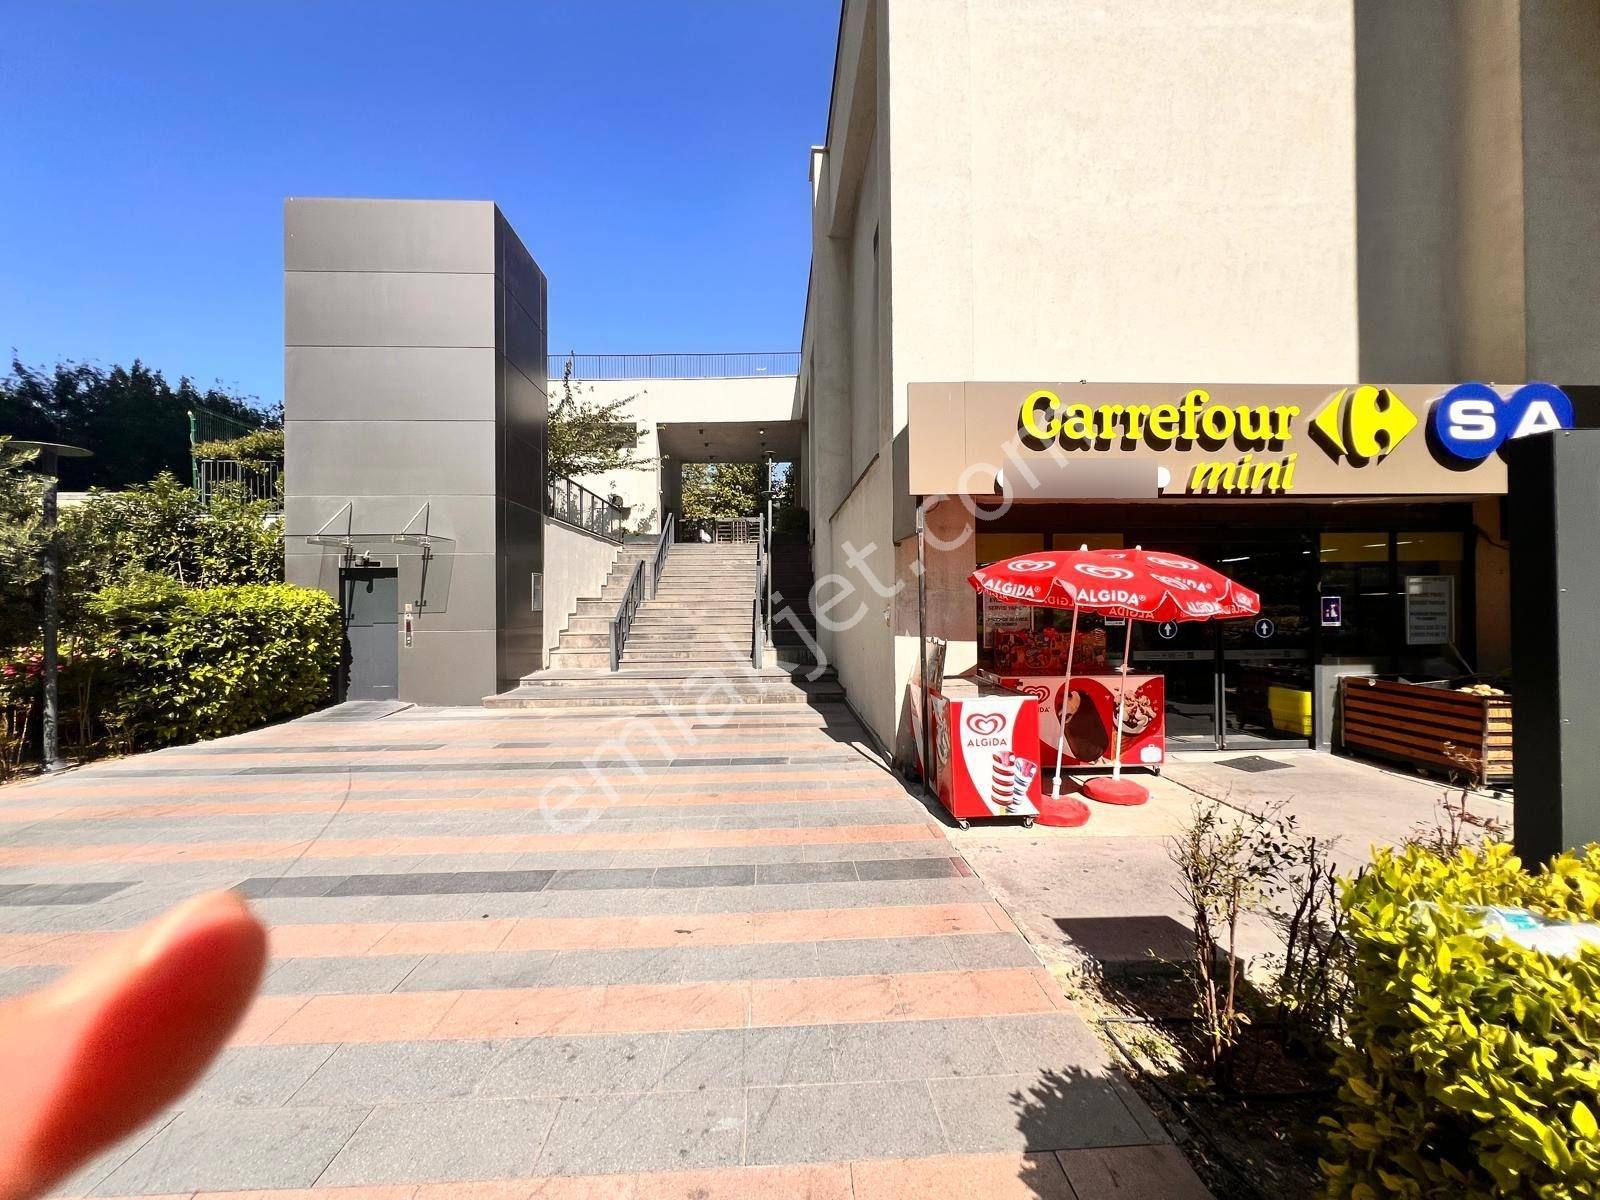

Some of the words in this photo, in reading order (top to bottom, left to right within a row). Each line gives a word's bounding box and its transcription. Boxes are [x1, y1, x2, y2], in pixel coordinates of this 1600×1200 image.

[1021, 390, 1300, 440] Carrefour
[1450, 400, 1562, 440] SA
[1190, 452, 1297, 490] mini
